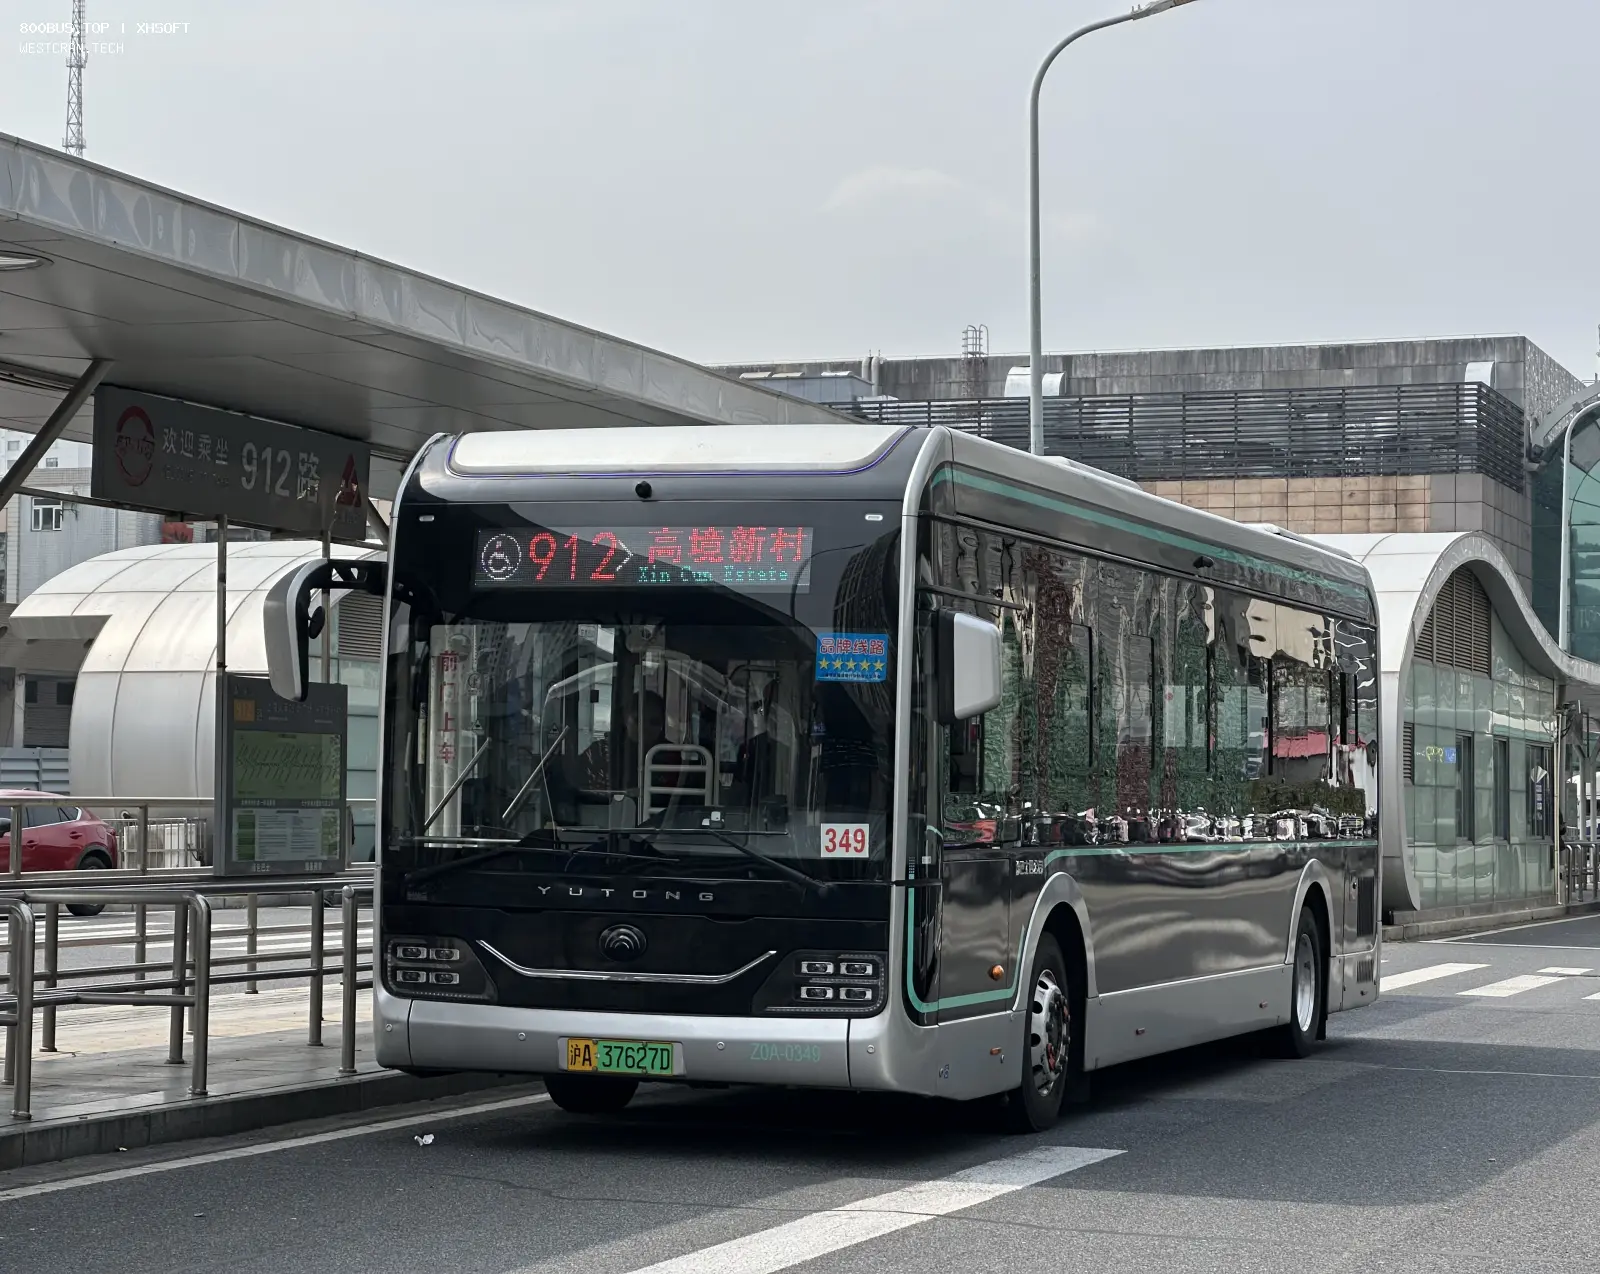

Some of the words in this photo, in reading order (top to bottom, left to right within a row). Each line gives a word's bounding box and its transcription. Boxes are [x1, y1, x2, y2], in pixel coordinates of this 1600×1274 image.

[162, 426, 230, 466] 欢迎乘坐
[528, 531, 618, 580] 912
[648, 525, 807, 564] 高境新村
[820, 637, 886, 656] 品牌线路
[437, 650, 458, 764] 前门上车
[824, 828, 866, 853] 349
[537, 885, 714, 902] YUTONG
